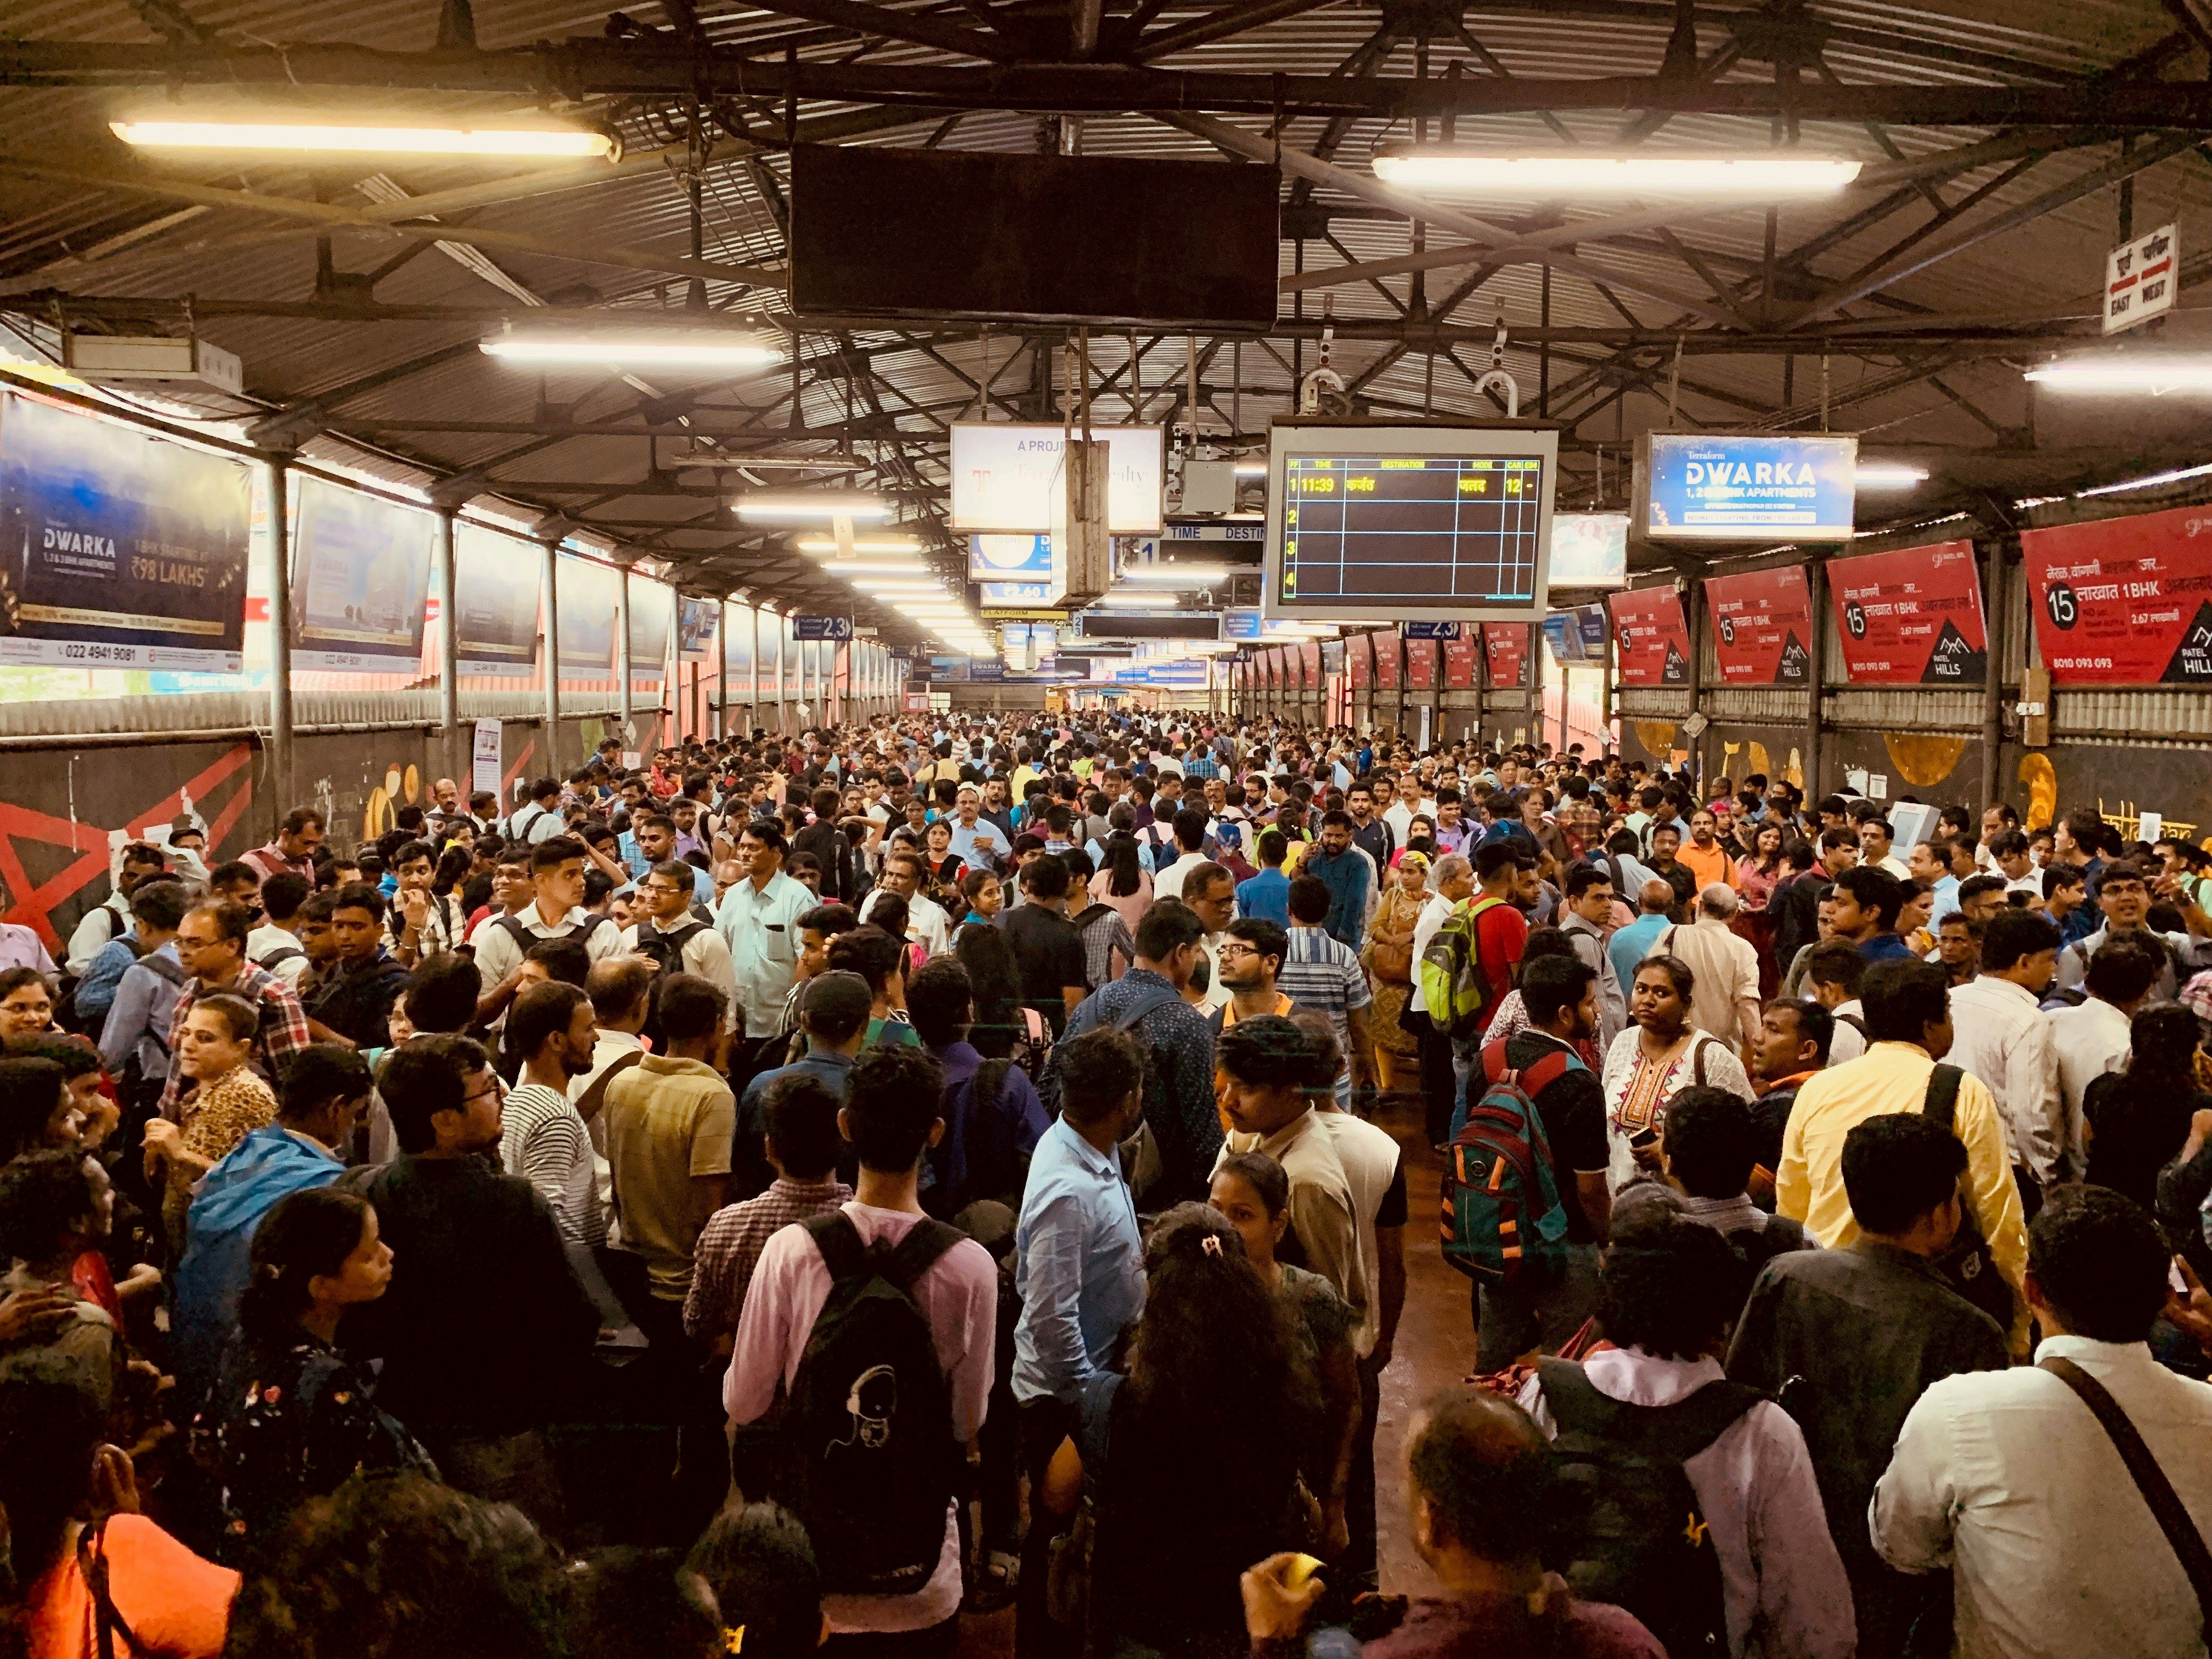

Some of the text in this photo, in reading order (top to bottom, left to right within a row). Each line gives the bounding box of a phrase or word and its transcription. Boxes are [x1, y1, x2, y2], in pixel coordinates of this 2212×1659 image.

[2111, 280, 2165, 317] EAST WEST
[1018, 441, 1026, 451] A
[1687, 450, 1725, 460] Terraform
[1686, 462, 1816, 485] DWARKA
[1290, 478, 1296, 492] 1
[1301, 478, 1334, 492] 11:39
[1506, 478, 1521, 493] 12
[1746, 487, 1816, 498] APARTMENTS
[1288, 509, 1296, 524] 2
[1171, 527, 1264, 539] TIME DESTIN
[44, 528, 116, 558] DWARKA
[1287, 540, 1295, 555] 3
[1142, 543, 1153, 567] 1
[1285, 572, 1294, 586] 4
[2049, 590, 2074, 622] 15
[2075, 584, 2119, 602] लाखात
[823, 617, 846, 638] 2,3
[1075, 617, 1081, 626] 2
[1847, 608, 1864, 633] 15
[1075, 627, 1081, 636] 3
[1432, 622, 1454, 638] 2,3
[1720, 619, 1734, 641] 15
[66, 644, 136, 662] 022 4941 9081
[909, 645, 918, 657] 4
[1237, 649, 1245, 661] 4
[2182, 648, 2207, 657] PATEL
[1784, 667, 1801, 677] HILLS
[1936, 664, 1961, 675] HILLS
